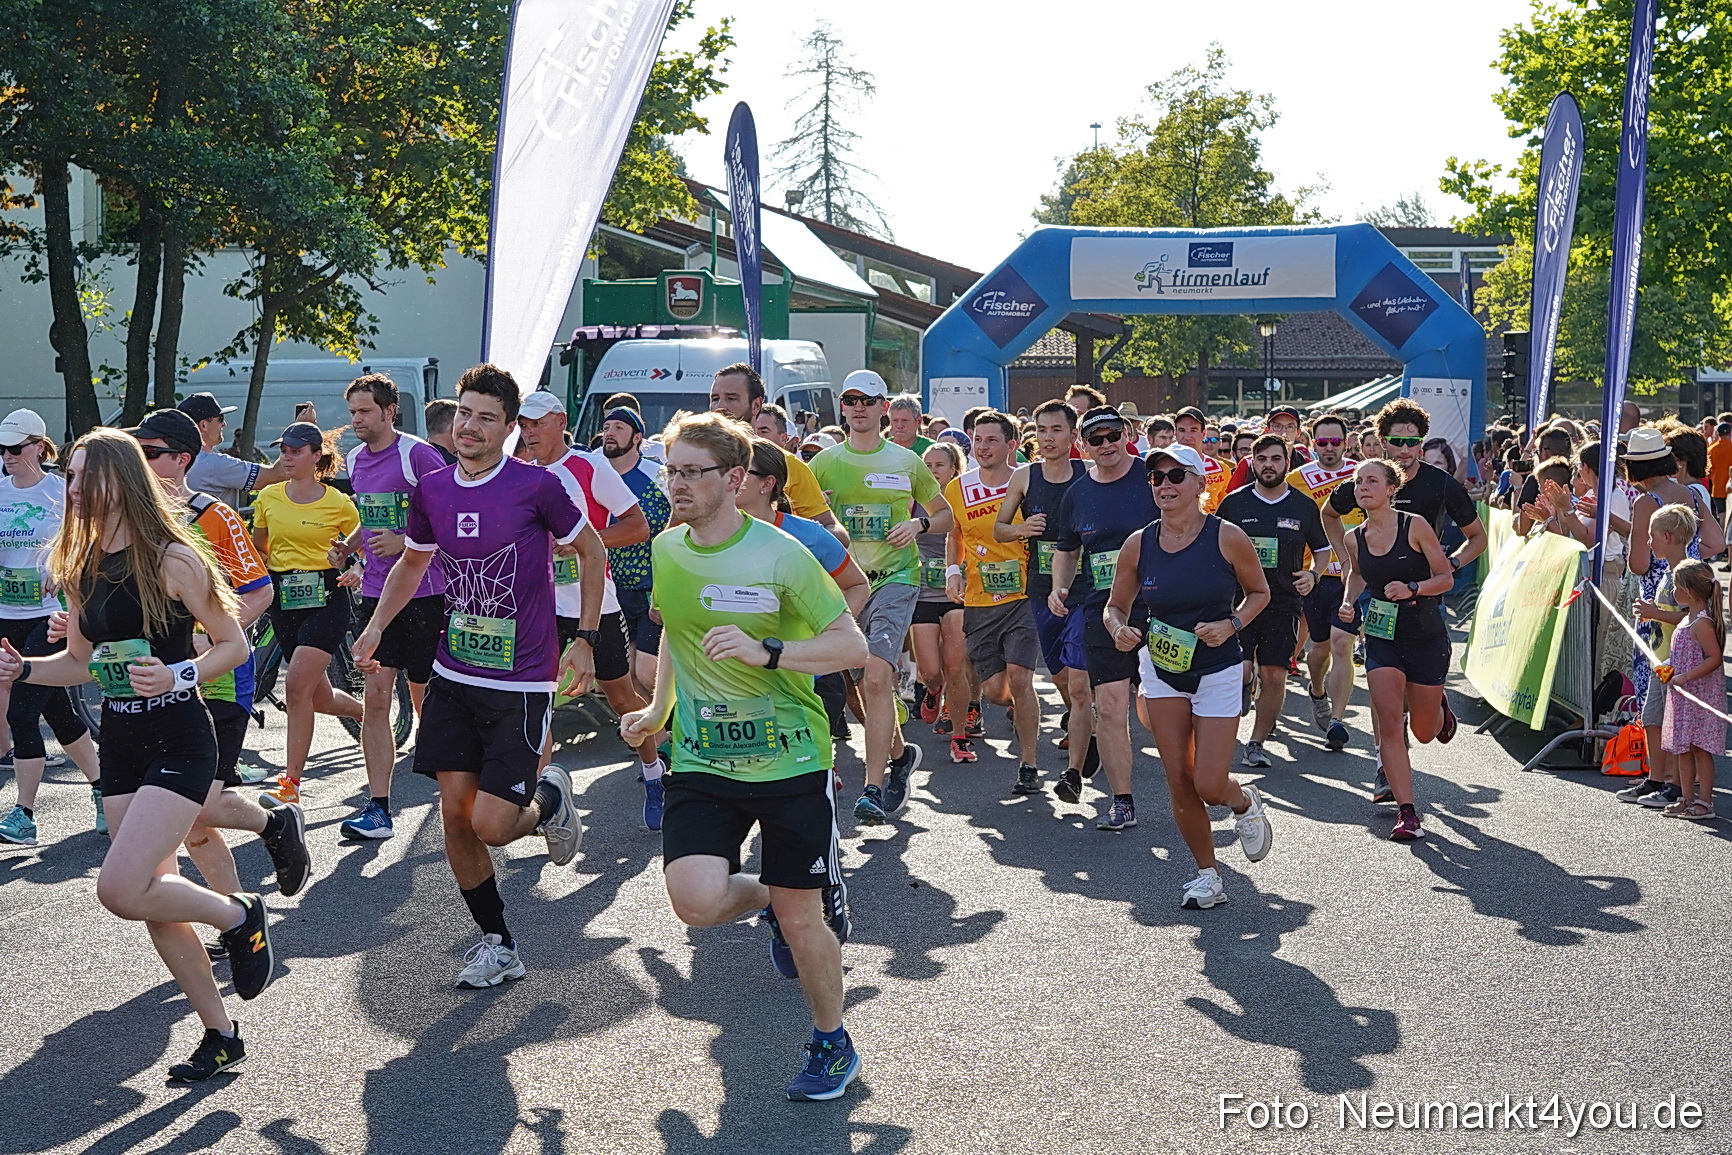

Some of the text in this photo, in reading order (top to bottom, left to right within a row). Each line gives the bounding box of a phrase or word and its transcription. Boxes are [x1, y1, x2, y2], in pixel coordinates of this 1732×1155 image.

[1549, 122, 1572, 233] Fischer
[1560, 138, 1576, 228] AUTOMOBILE
[1197, 251, 1231, 260] Fischer
[1172, 267, 1271, 287] firmenlauf
[982, 299, 1036, 312] Fischer
[1367, 299, 1382, 309] und
[1383, 297, 1397, 306] das
[986, 310, 1032, 318] AUTOMOBILE
[603, 368, 648, 379] abavent
[363, 505, 389, 518] 1873
[966, 504, 998, 521] MAX
[849, 516, 881, 529] 1141
[986, 572, 1014, 584] 1654
[5, 580, 27, 594] 361
[290, 584, 313, 599] 559
[734, 589, 759, 597] Klinikum
[1367, 610, 1386, 626] 897
[458, 630, 503, 652] 1528
[1155, 637, 1180, 659] 495
[503, 639, 512, 663] 2022
[107, 688, 192, 714] NIKE PRO
[701, 726, 710, 748] RUN
[714, 720, 757, 742] 160
[765, 720, 777, 749] 2022
[732, 740, 769, 749] Alexander
